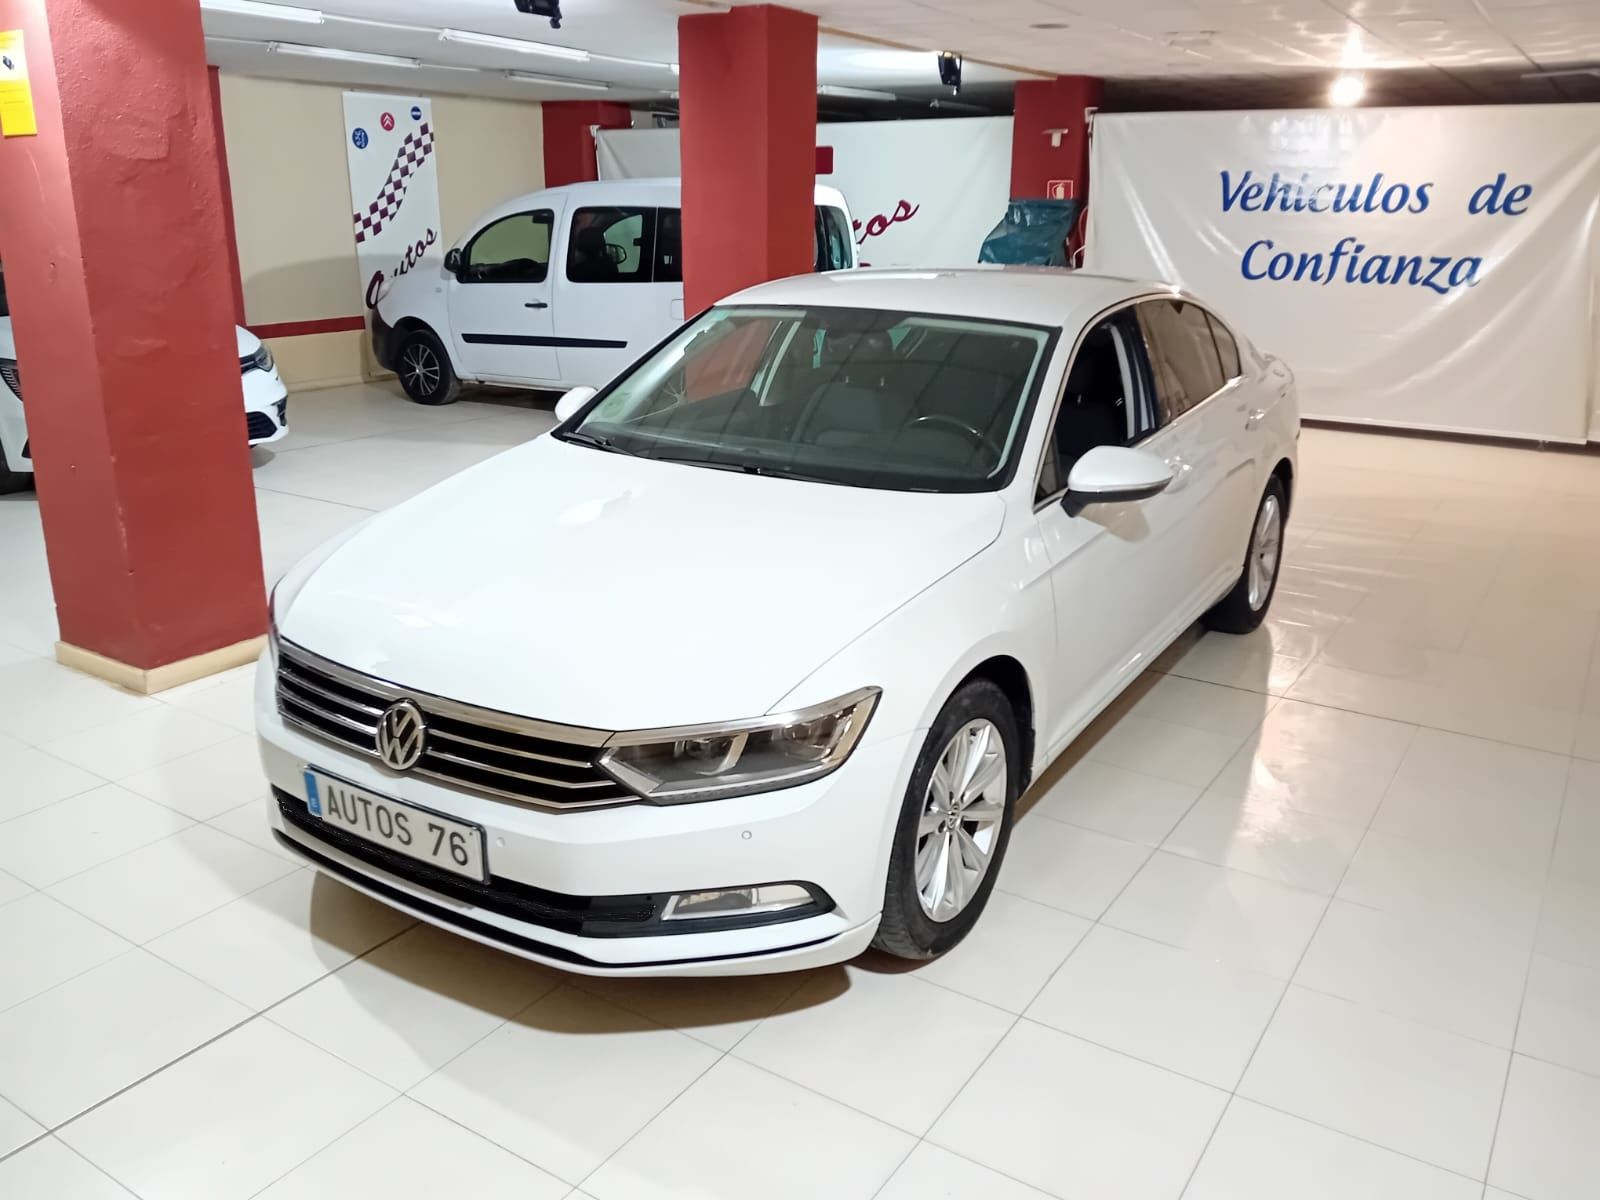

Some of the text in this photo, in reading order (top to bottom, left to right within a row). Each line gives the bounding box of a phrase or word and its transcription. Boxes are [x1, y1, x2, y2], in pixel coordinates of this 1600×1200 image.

[1220, 170, 1533, 216] Vehiculos de
[1240, 236, 1483, 295] Confianza
[327, 785, 468, 866] AUTOS 76
